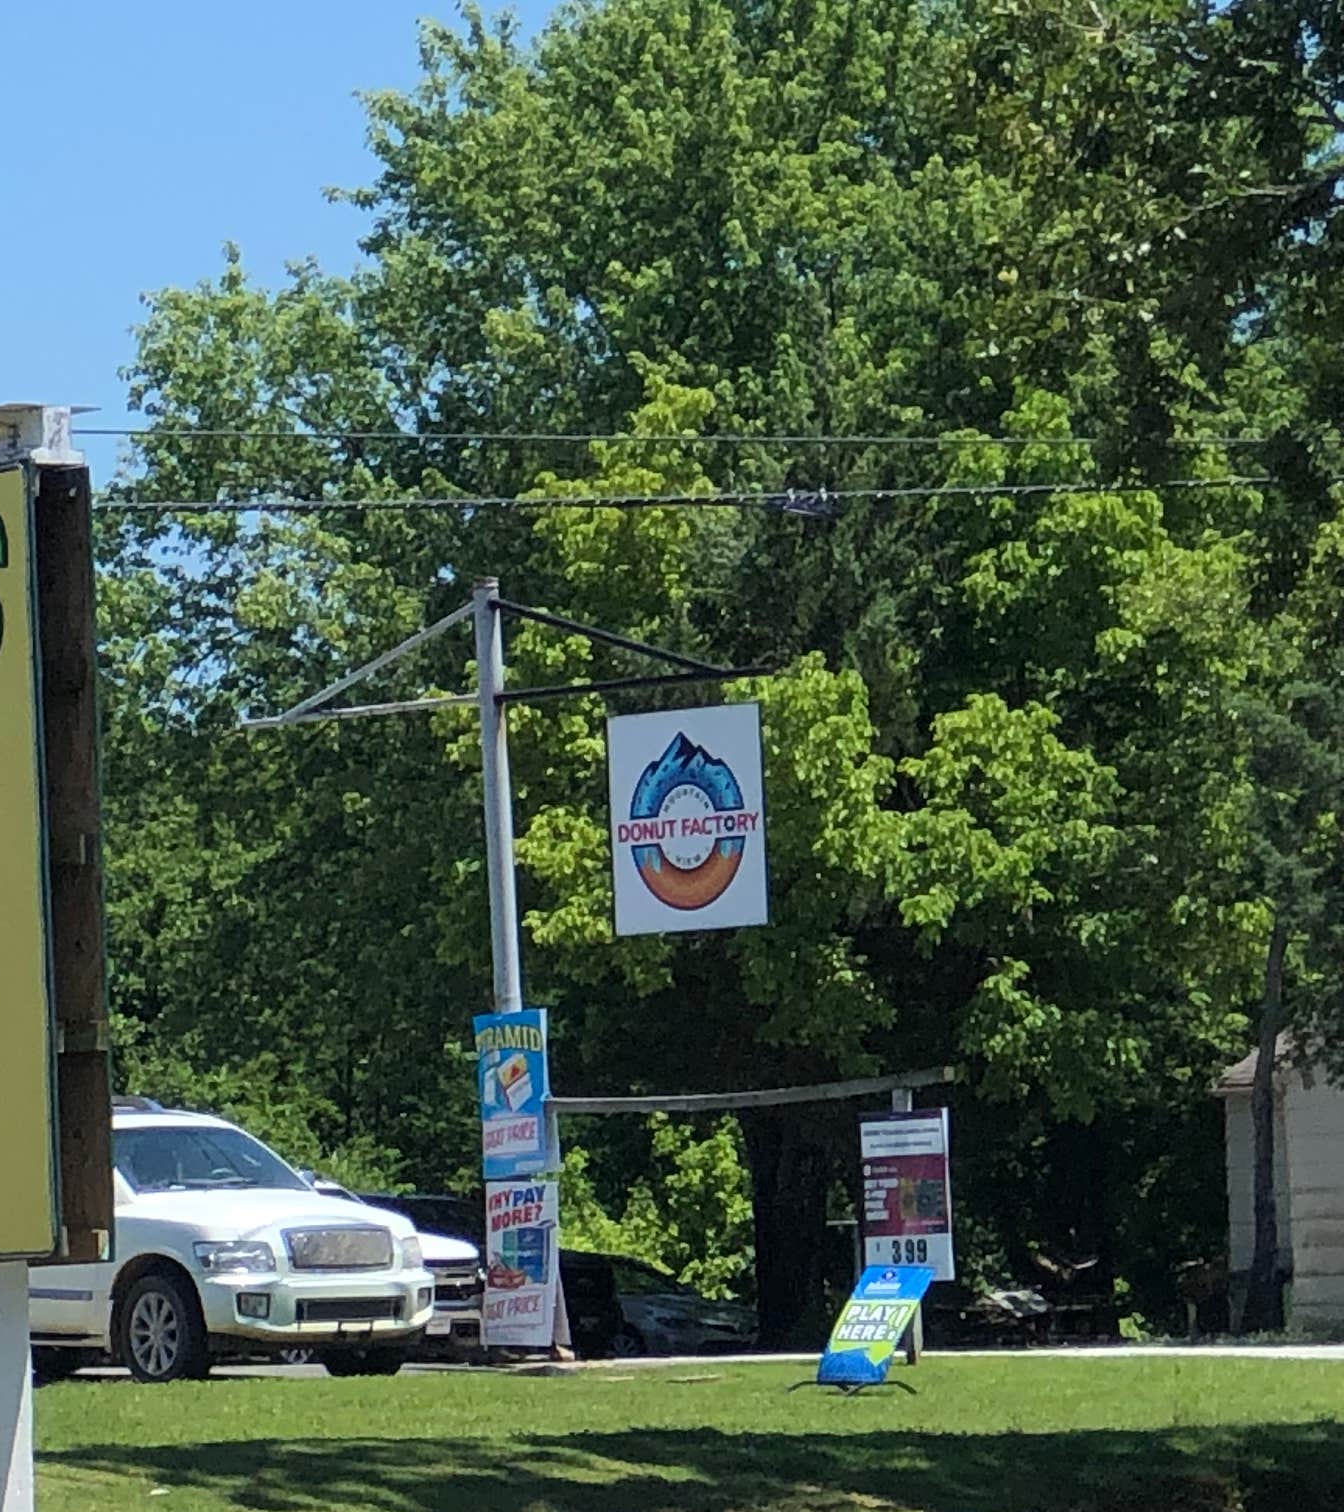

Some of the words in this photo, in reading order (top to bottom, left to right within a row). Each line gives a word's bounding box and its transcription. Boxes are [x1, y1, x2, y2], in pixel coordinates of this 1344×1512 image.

[618, 819, 677, 843] DONUT
[681, 812, 760, 838] FACTORY
[512, 1184, 546, 1207] PAY
[491, 1204, 543, 1232] MORE?
